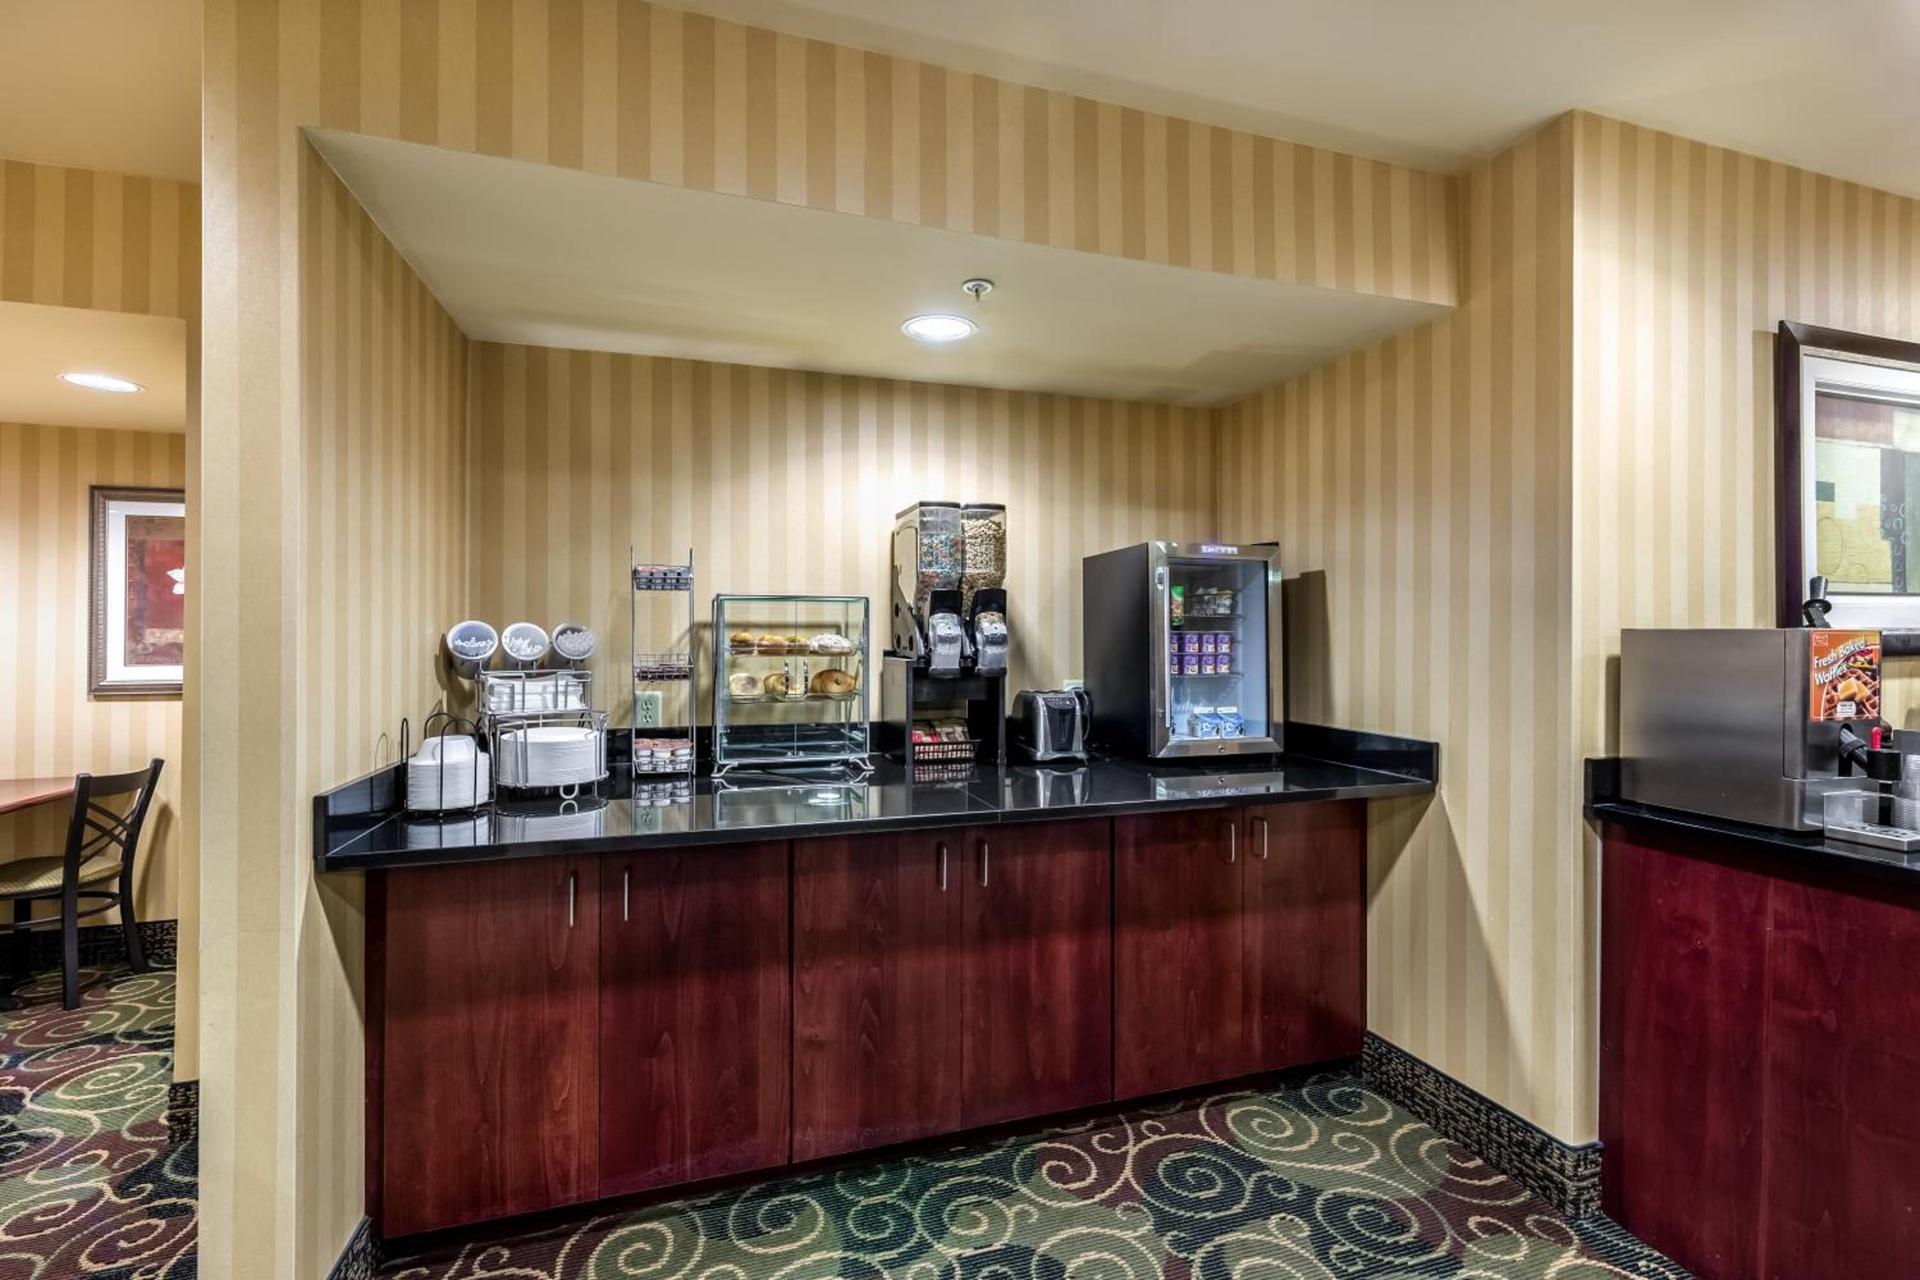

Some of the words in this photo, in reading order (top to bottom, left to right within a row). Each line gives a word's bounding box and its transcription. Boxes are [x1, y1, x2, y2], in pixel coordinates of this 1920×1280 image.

[1814, 648, 1837, 669] Fresh
[1840, 634, 1866, 657] Baked
[1814, 661, 1848, 685] Waffles
